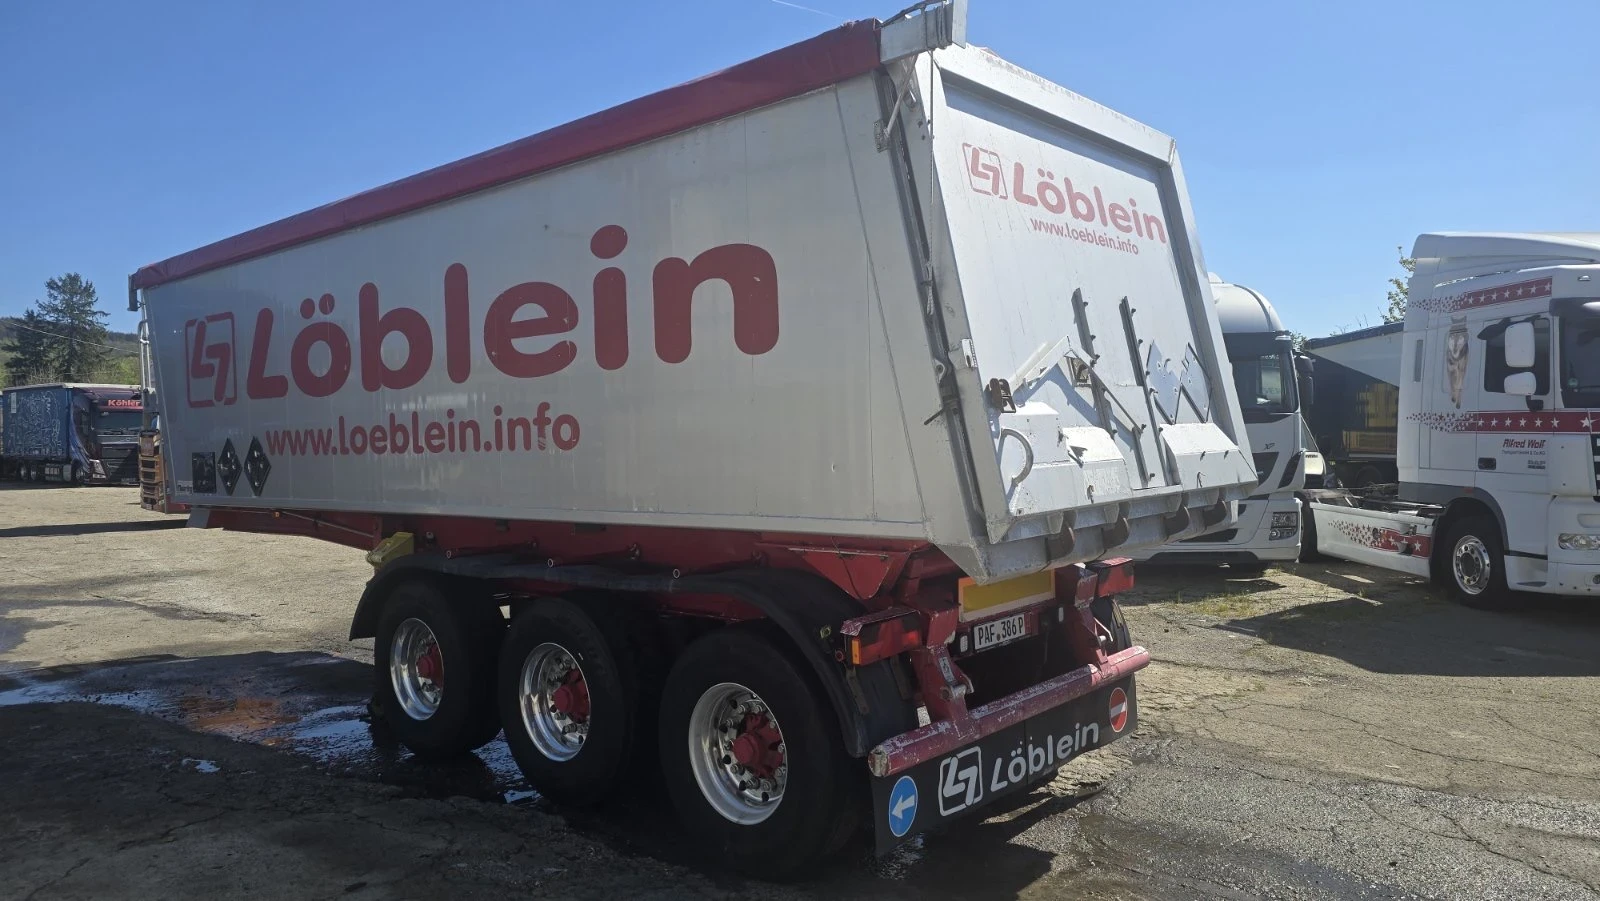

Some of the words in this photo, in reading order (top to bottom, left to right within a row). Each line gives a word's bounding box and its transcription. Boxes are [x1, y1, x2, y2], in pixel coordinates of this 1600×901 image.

[1013, 161, 1167, 244] Löblein
[1030, 218, 1139, 256] www.loeblein.info
[247, 224, 780, 400] Löblein
[108, 399, 141, 407] Köhler
[266, 401, 581, 456] www.loeblein.info
[978, 623, 995, 646] PAF
[990, 722, 1099, 793] Löblein
